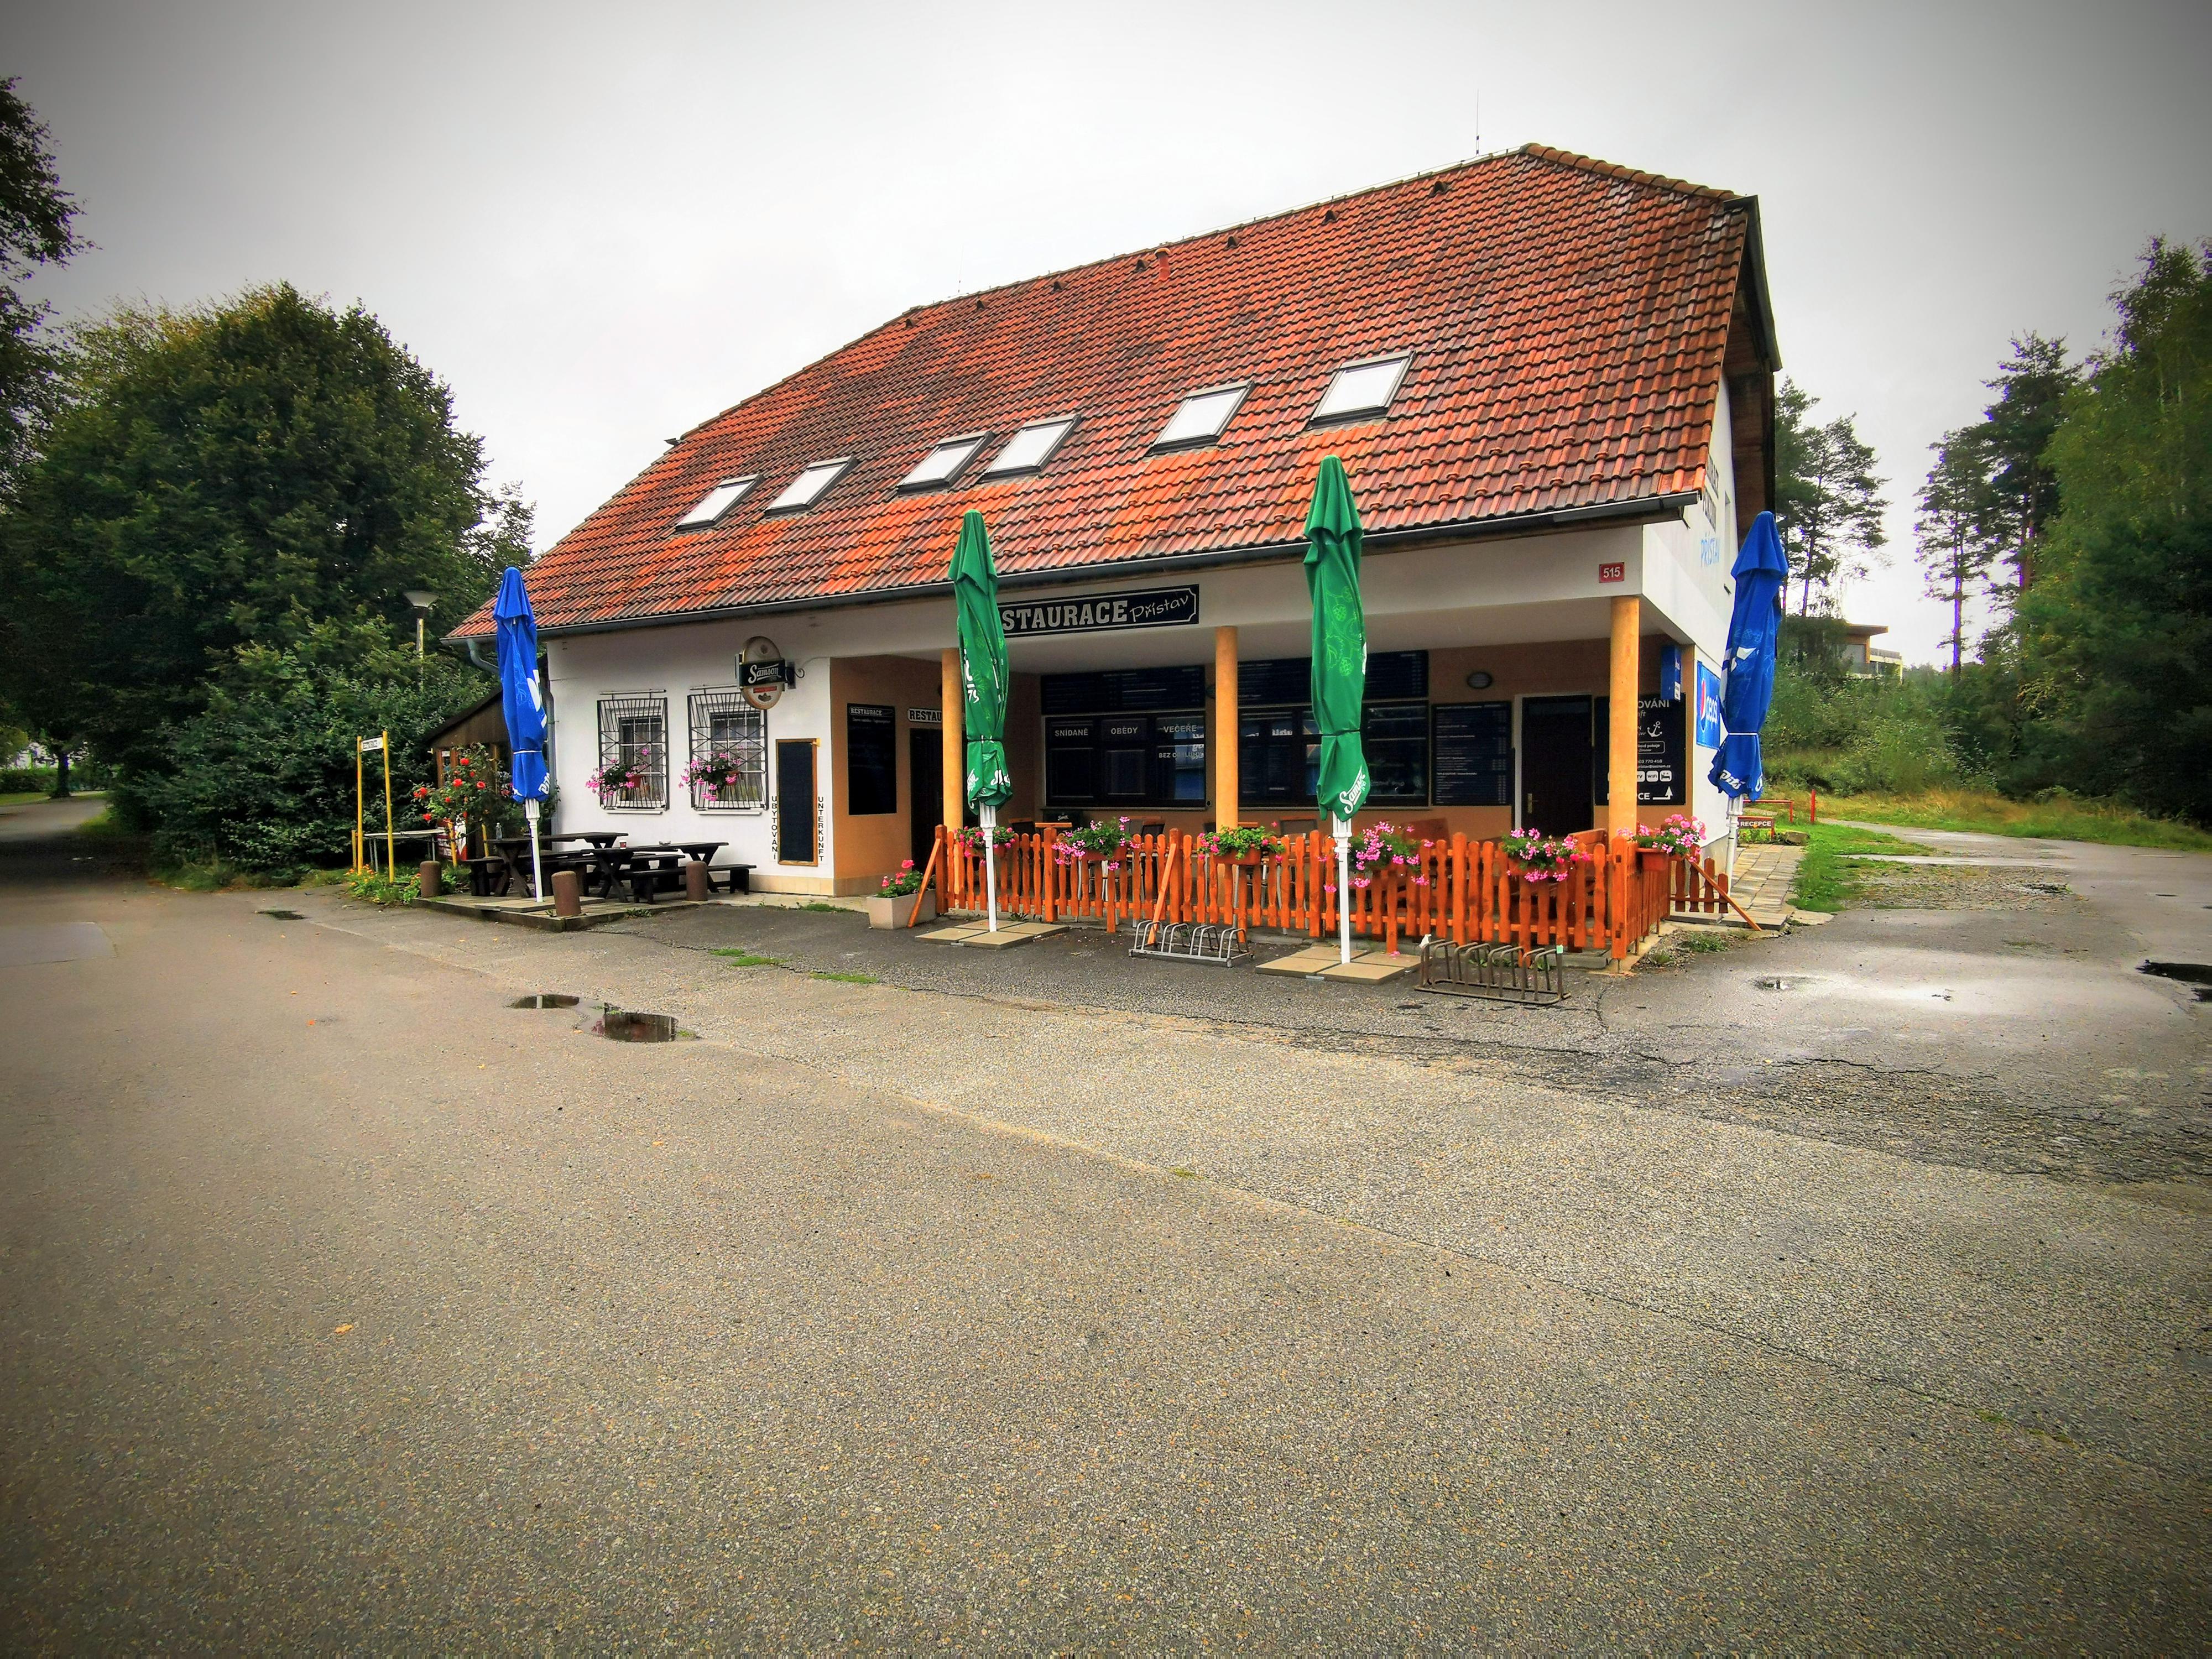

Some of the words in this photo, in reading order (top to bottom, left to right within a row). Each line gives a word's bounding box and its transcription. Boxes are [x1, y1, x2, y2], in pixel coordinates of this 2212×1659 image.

[1603, 567, 1620, 578] 515
[1001, 600, 1128, 630] STAURACE
[1130, 594, 1189, 622] Přístav
[748, 664, 781, 684] Samson
[909, 710, 941, 721] RESTAU
[1055, 728, 1088, 737] SNÍDANĚ
[1110, 726, 1138, 735] OBĚDY
[1164, 723, 1197, 733] VEČEŘE
